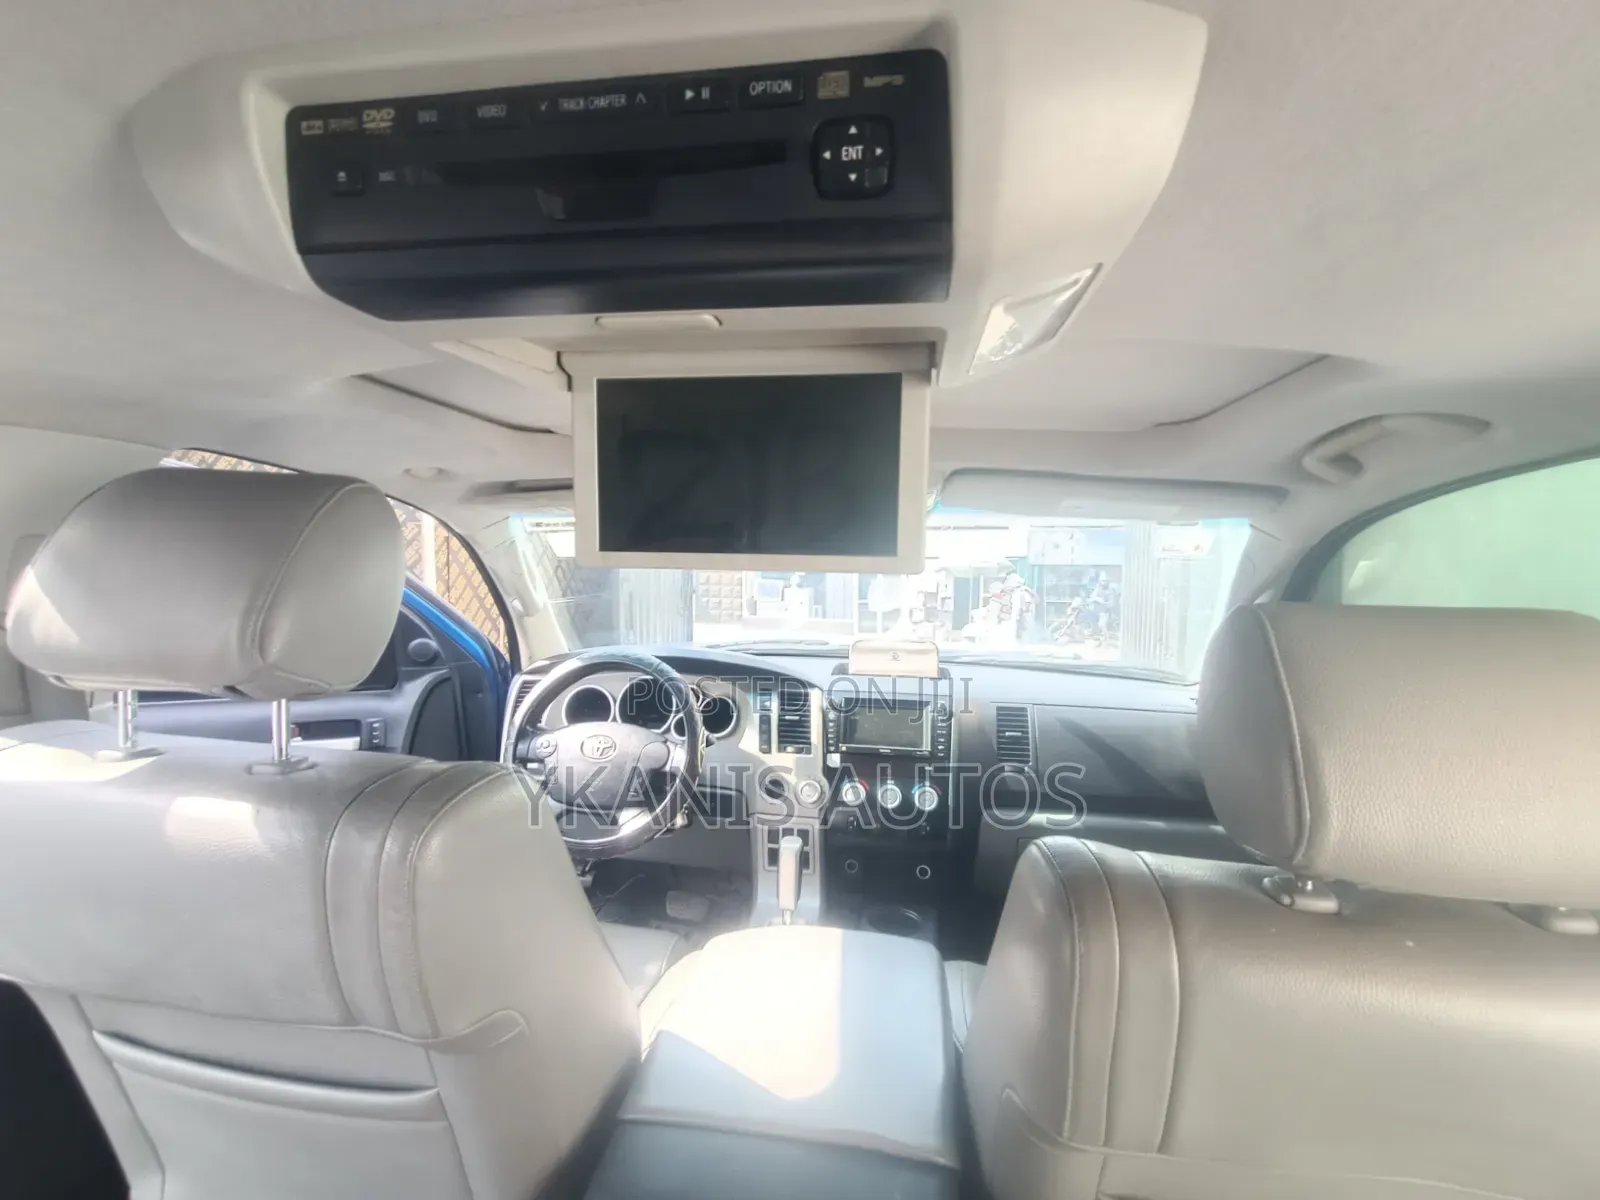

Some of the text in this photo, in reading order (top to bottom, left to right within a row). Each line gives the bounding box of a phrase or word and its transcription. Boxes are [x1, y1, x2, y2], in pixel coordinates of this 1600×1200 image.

[750, 80, 792, 96] OPTION
[588, 94, 627, 110] CHAPTER
[363, 108, 395, 122] DVD
[477, 104, 507, 118] VIDEO
[842, 146, 864, 161] ENT
